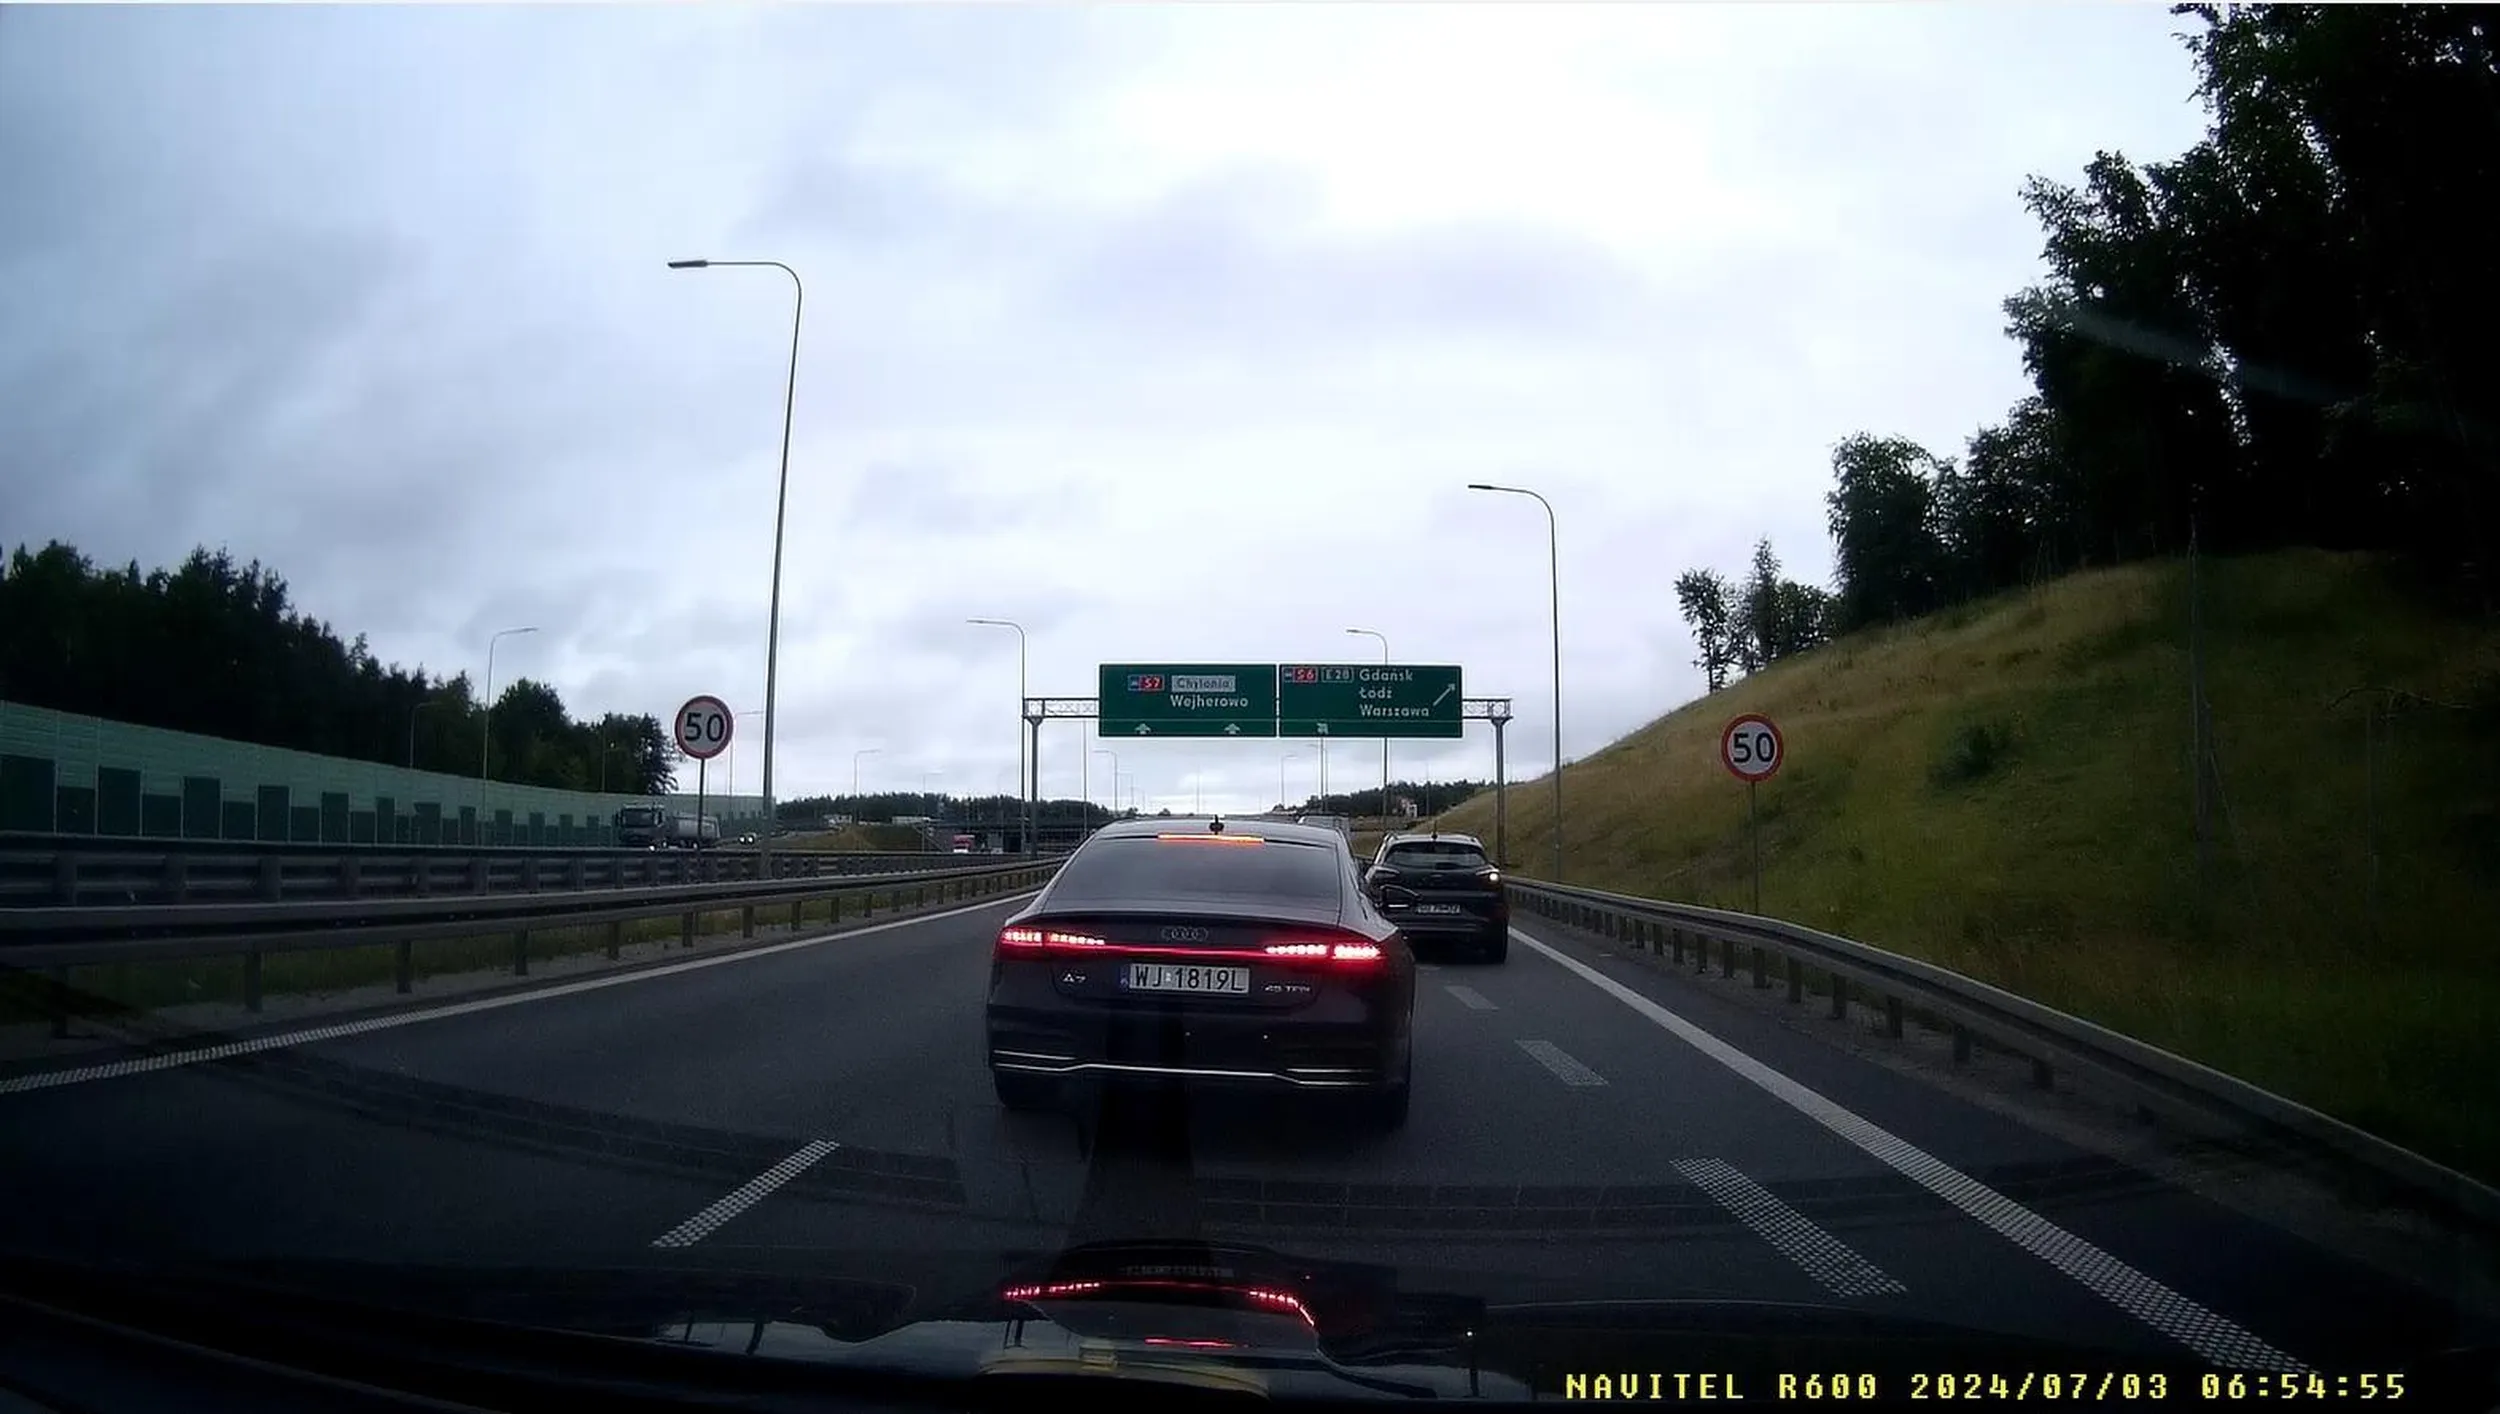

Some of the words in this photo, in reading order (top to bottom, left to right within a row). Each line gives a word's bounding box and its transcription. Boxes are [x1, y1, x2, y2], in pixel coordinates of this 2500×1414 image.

[1297, 669, 1314, 681] S6
[1359, 667, 1413, 681] Gdańsk
[1144, 677, 1160, 688] S7
[1359, 686, 1392, 699] Łódź
[1170, 694, 1249, 710] Wejherowo
[1359, 703, 1430, 717] Warszawa
[685, 712, 724, 742] 50
[1733, 732, 1775, 763] 50
[1135, 966, 1162, 987] WJ
[1175, 967, 1247, 991] 1819L
